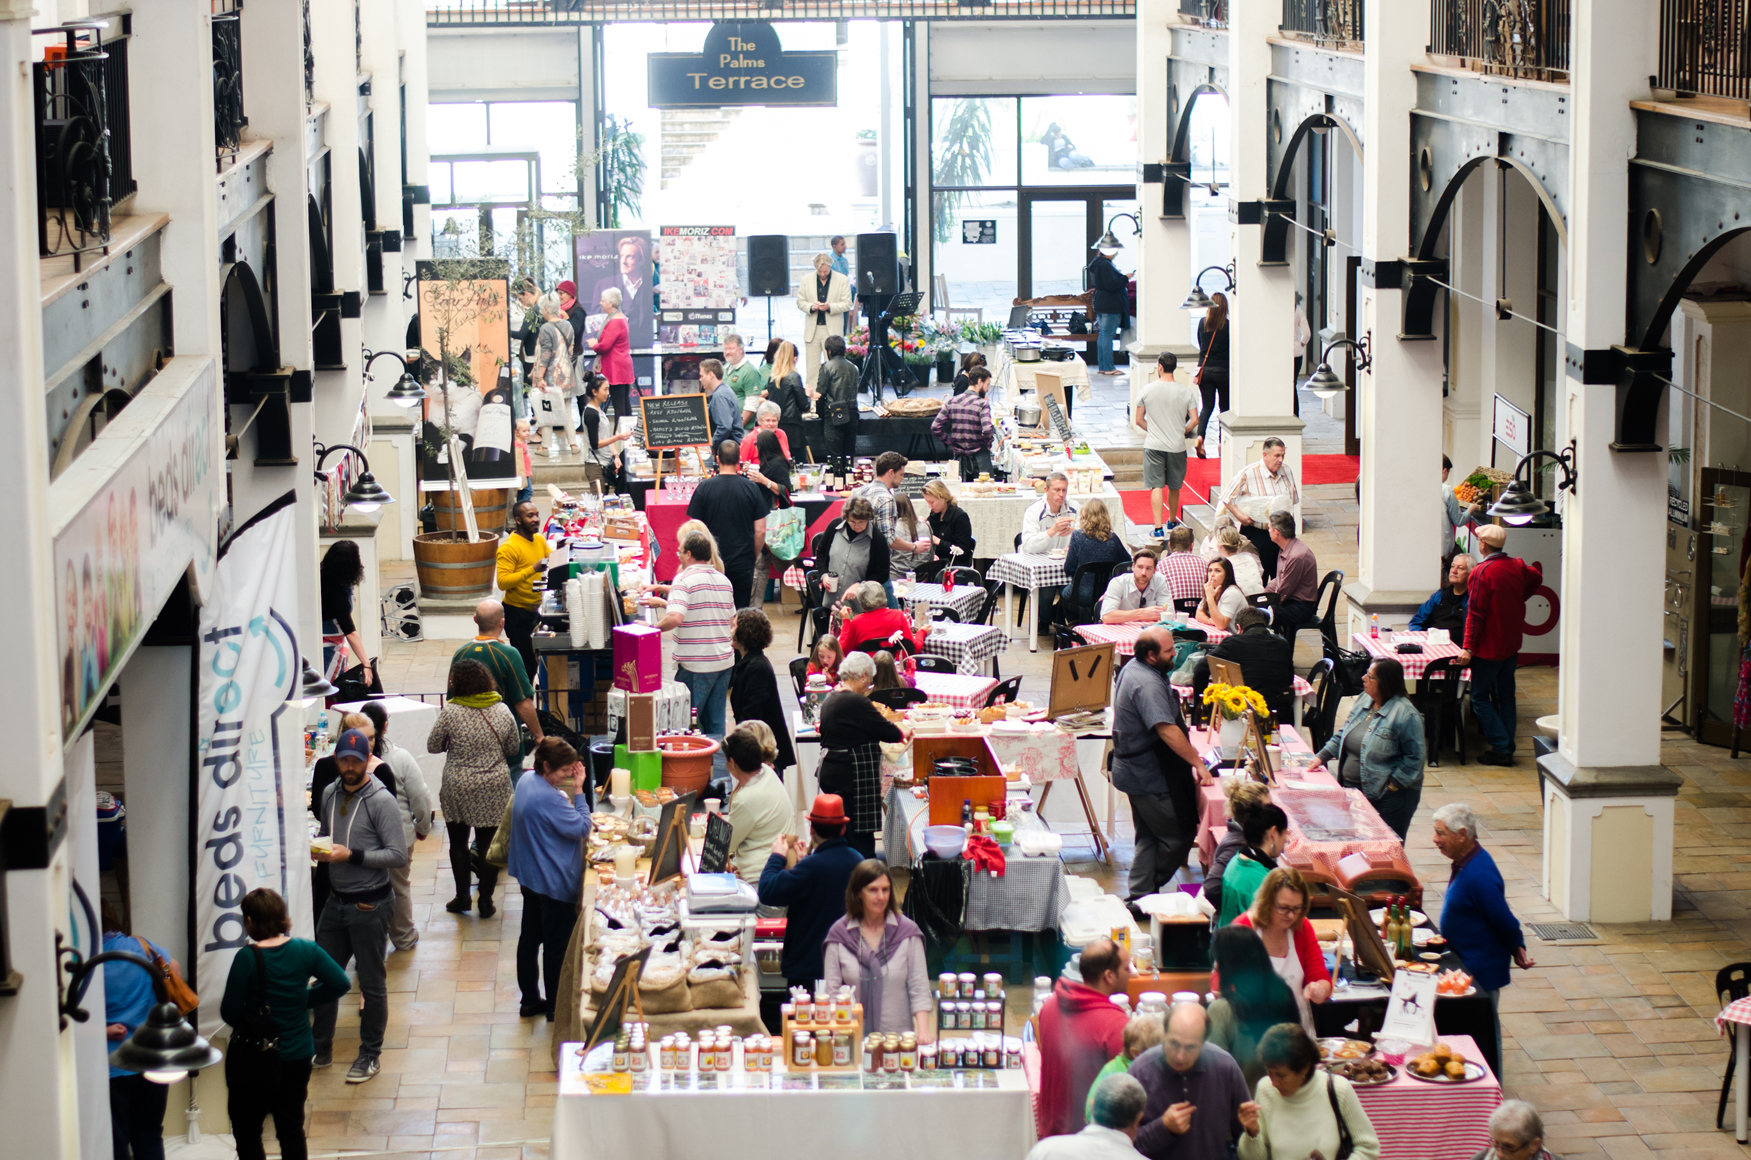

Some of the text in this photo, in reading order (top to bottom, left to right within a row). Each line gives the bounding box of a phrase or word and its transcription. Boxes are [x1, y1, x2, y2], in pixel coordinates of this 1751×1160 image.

[728, 37, 756, 51] The
[720, 53, 766, 68] Palms
[686, 73, 805, 89] Terrace
[663, 227, 733, 236] IKEMORIZ.COM
[148, 439, 180, 550] beds
[181, 394, 211, 504] direct
[203, 626, 250, 954] beds direct
[246, 729, 275, 879] FURNITURE
